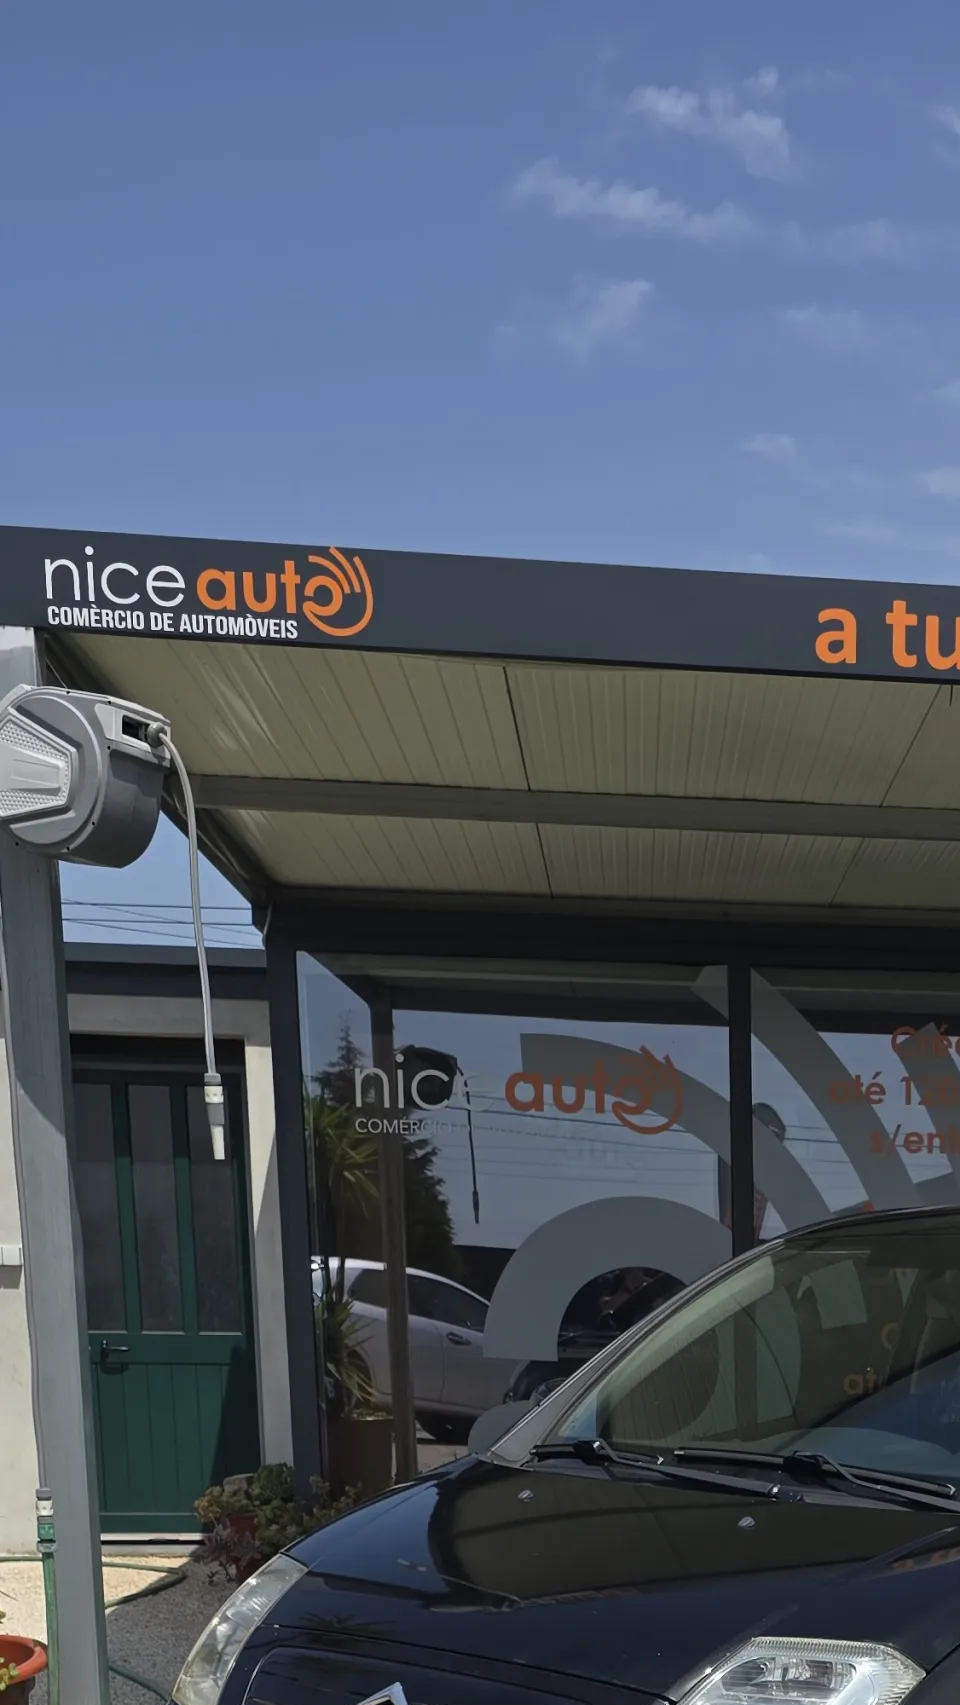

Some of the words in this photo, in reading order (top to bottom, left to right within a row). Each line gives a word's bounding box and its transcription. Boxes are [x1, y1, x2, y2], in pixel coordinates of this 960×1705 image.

[149, 610, 175, 633] DE
[814, 607, 858, 665] a
[827, 1070, 887, 1106] até
[899, 1075, 960, 1108] 120
